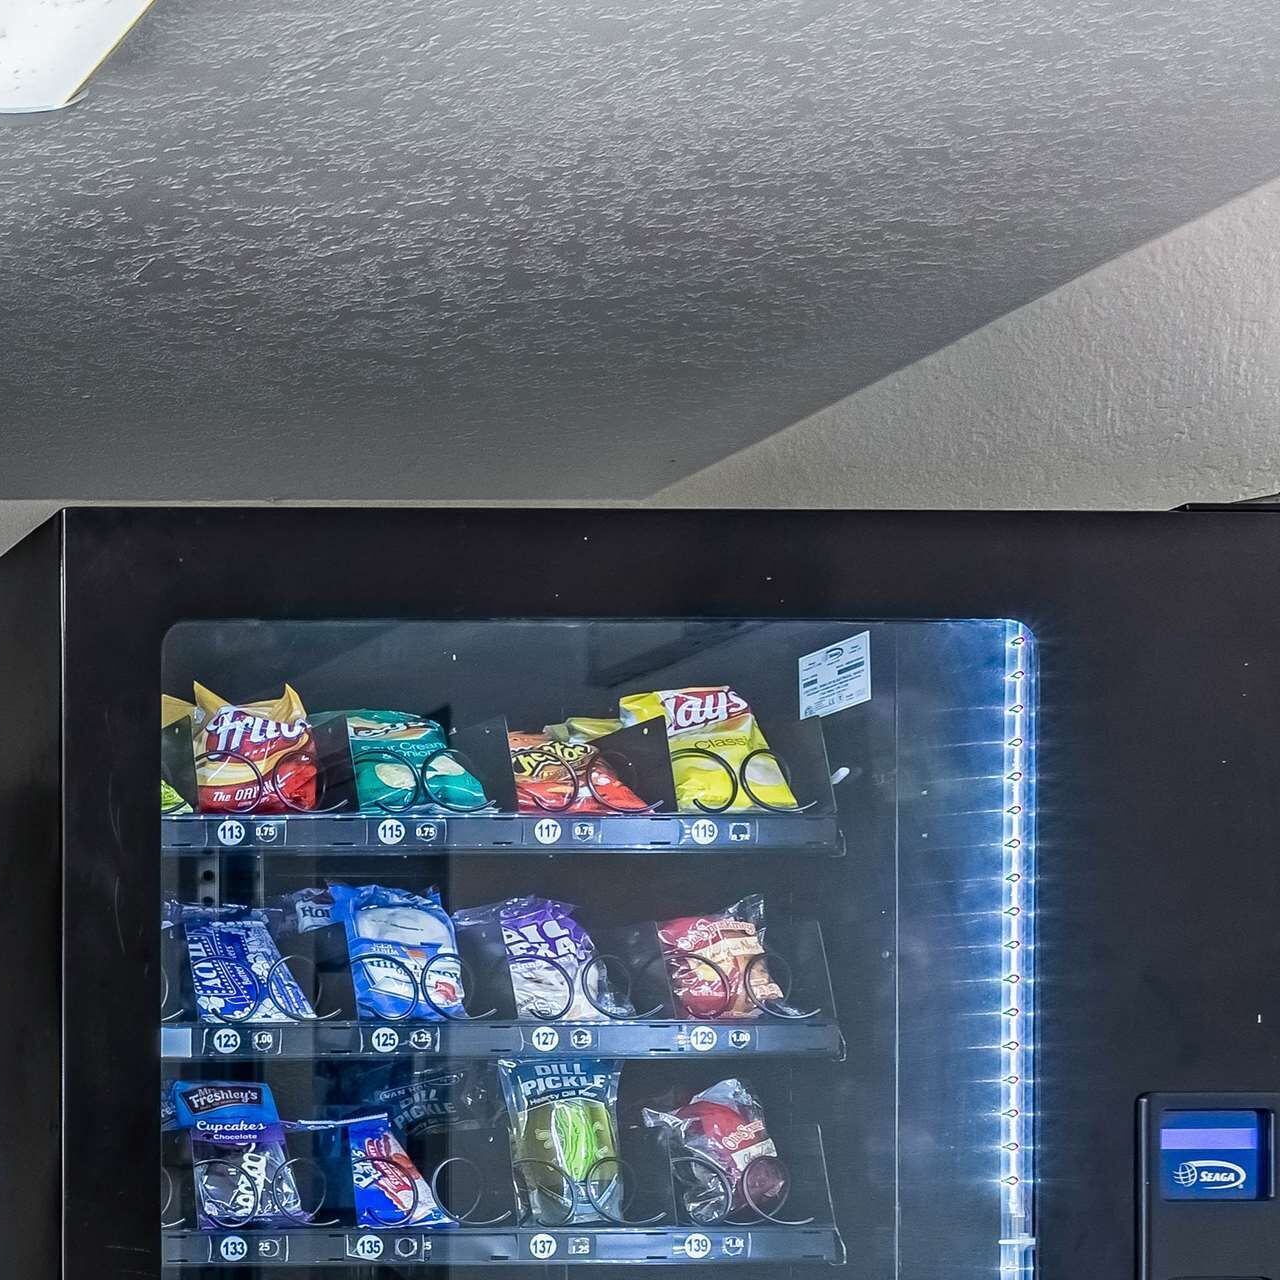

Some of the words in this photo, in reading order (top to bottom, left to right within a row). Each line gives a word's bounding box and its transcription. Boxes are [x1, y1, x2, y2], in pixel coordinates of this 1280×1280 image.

[220, 824, 243, 840] 113
[255, 826, 276, 836] 0.75
[380, 823, 403, 839] 115
[415, 826, 436, 836] 0.75
[537, 823, 558, 838] 117
[694, 823, 715, 838] 119
[216, 1032, 238, 1047] 123
[254, 1034, 272, 1044] 1.00
[375, 1032, 397, 1047] 125
[413, 1033, 432, 1044] 1.25
[535, 1031, 556, 1046] 127
[692, 1031, 715, 1046] 129
[731, 1032, 751, 1043] 1.00
[534, 1063, 587, 1076] DILL
[521, 1074, 607, 1096] PICKLE
[189, 1089, 258, 1108] Freshley's
[196, 1120, 267, 1133] Cupcakes
[1199, 1171, 1235, 1182] SEAGA
[222, 1241, 245, 1256] 133
[359, 1239, 381, 1254] 135
[533, 1239, 553, 1254] 137
[688, 1238, 708, 1252] 139
